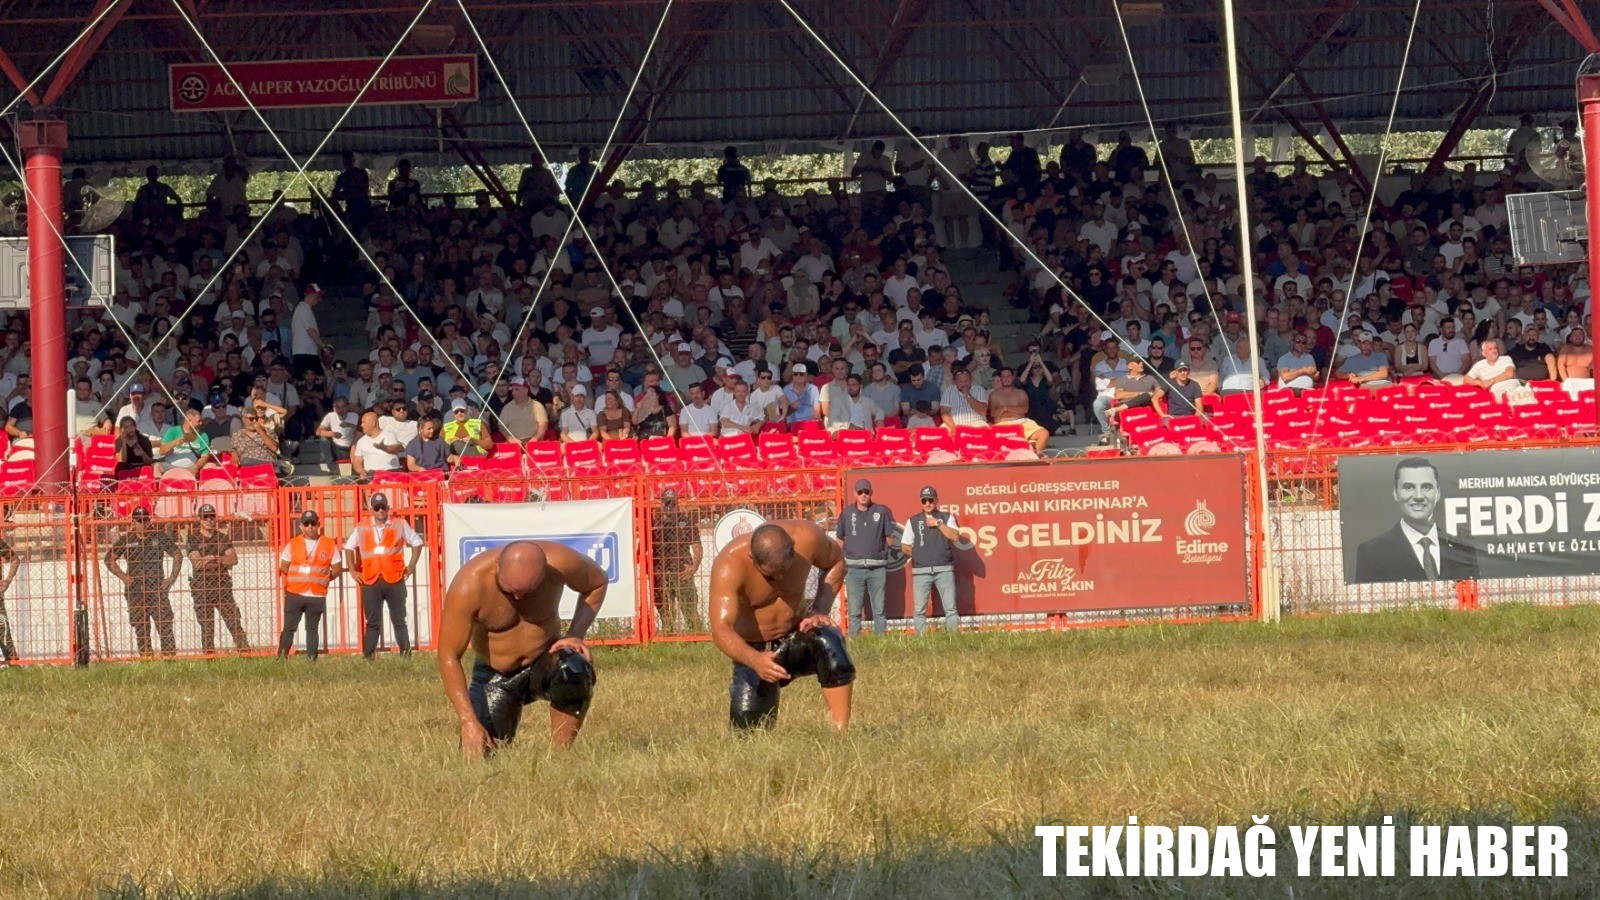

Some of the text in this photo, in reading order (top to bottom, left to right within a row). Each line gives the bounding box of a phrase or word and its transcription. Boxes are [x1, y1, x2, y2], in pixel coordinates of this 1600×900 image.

[249, 80, 293, 94] ALPER
[298, 75, 363, 93] YAZOĞLU
[372, 71, 437, 91] TRİBÜNÜ
[966, 480, 1120, 496] DEĞERLİ GÜREŞSEVERLER
[1459, 476, 1505, 489] MERHUM
[1507, 475, 1547, 488] MANİSA
[964, 501, 1040, 516] MEYDANI
[952, 512, 1163, 556] OŞ GELDİNİZ
[1176, 539, 1229, 555] Edirne
[1487, 542, 1544, 555] RAHMET
[1548, 541, 1565, 552] VE
[1182, 554, 1223, 564] Belediyesi
[1017, 558, 1076, 585] Av. Filiz
[1001, 580, 1095, 594] GENCAN AKIN
